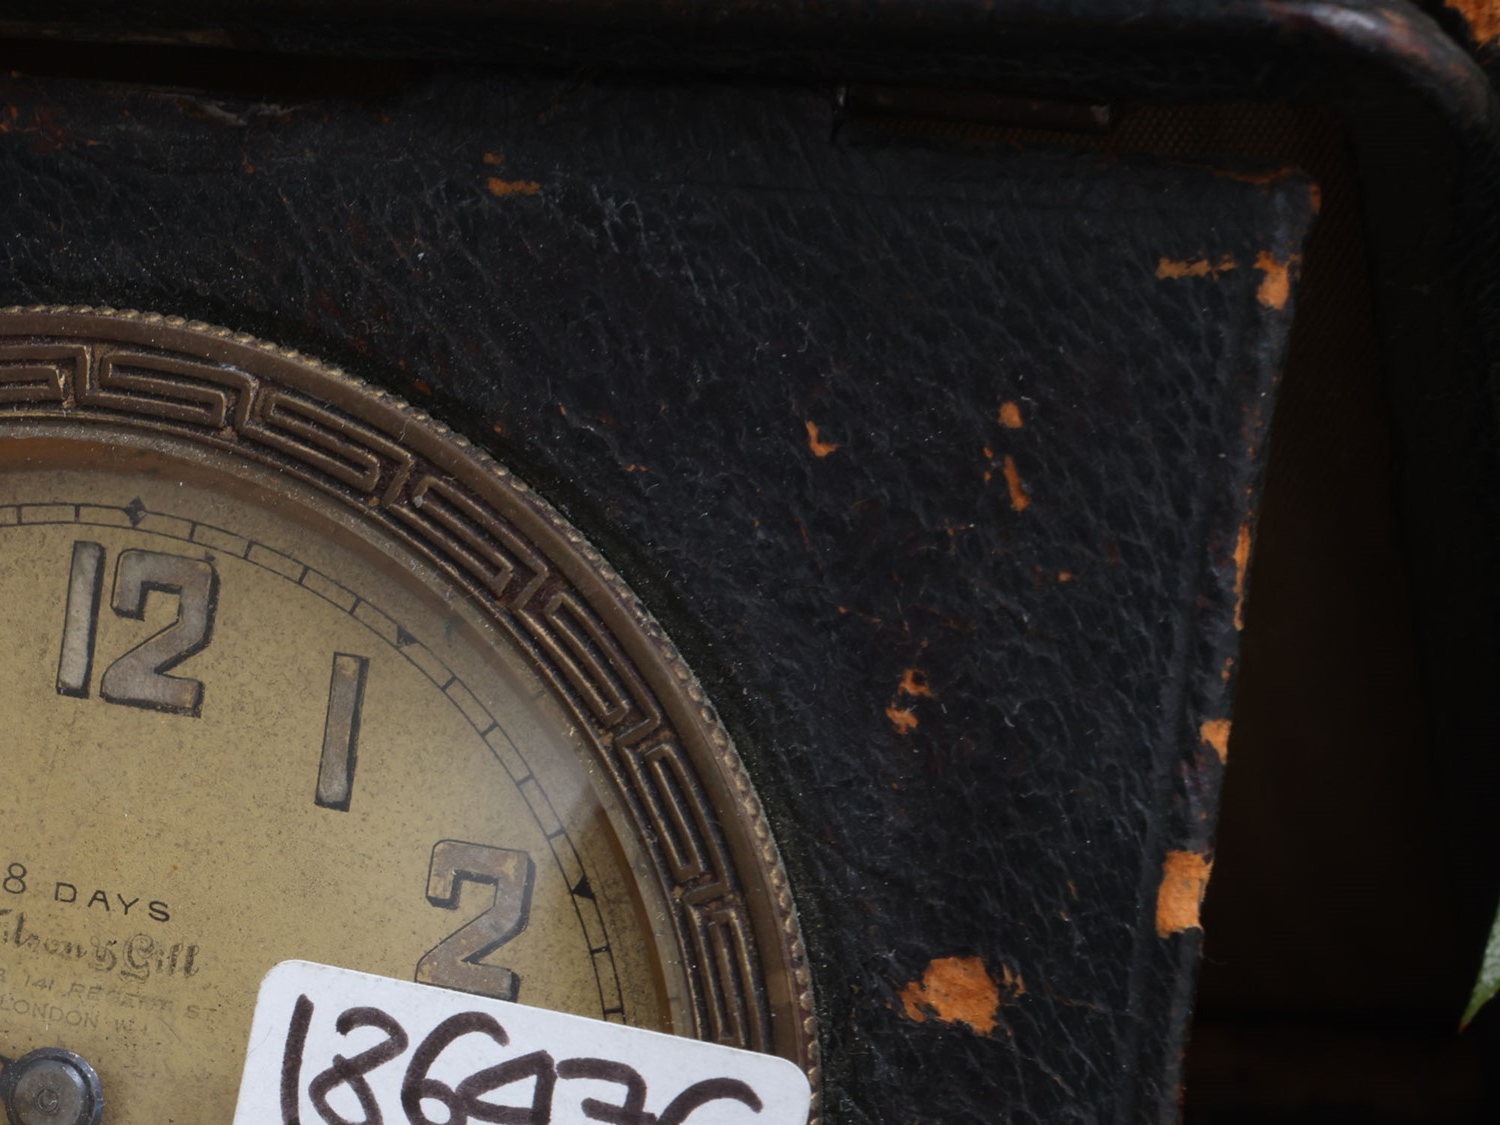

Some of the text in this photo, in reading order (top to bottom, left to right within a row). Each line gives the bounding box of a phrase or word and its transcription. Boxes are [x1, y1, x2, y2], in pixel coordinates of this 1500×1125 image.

[56, 541, 221, 717] 12
[314, 651, 369, 812] 1
[2, 862, 171, 923] 8 DAYS
[415, 838, 536, 1002] 2
